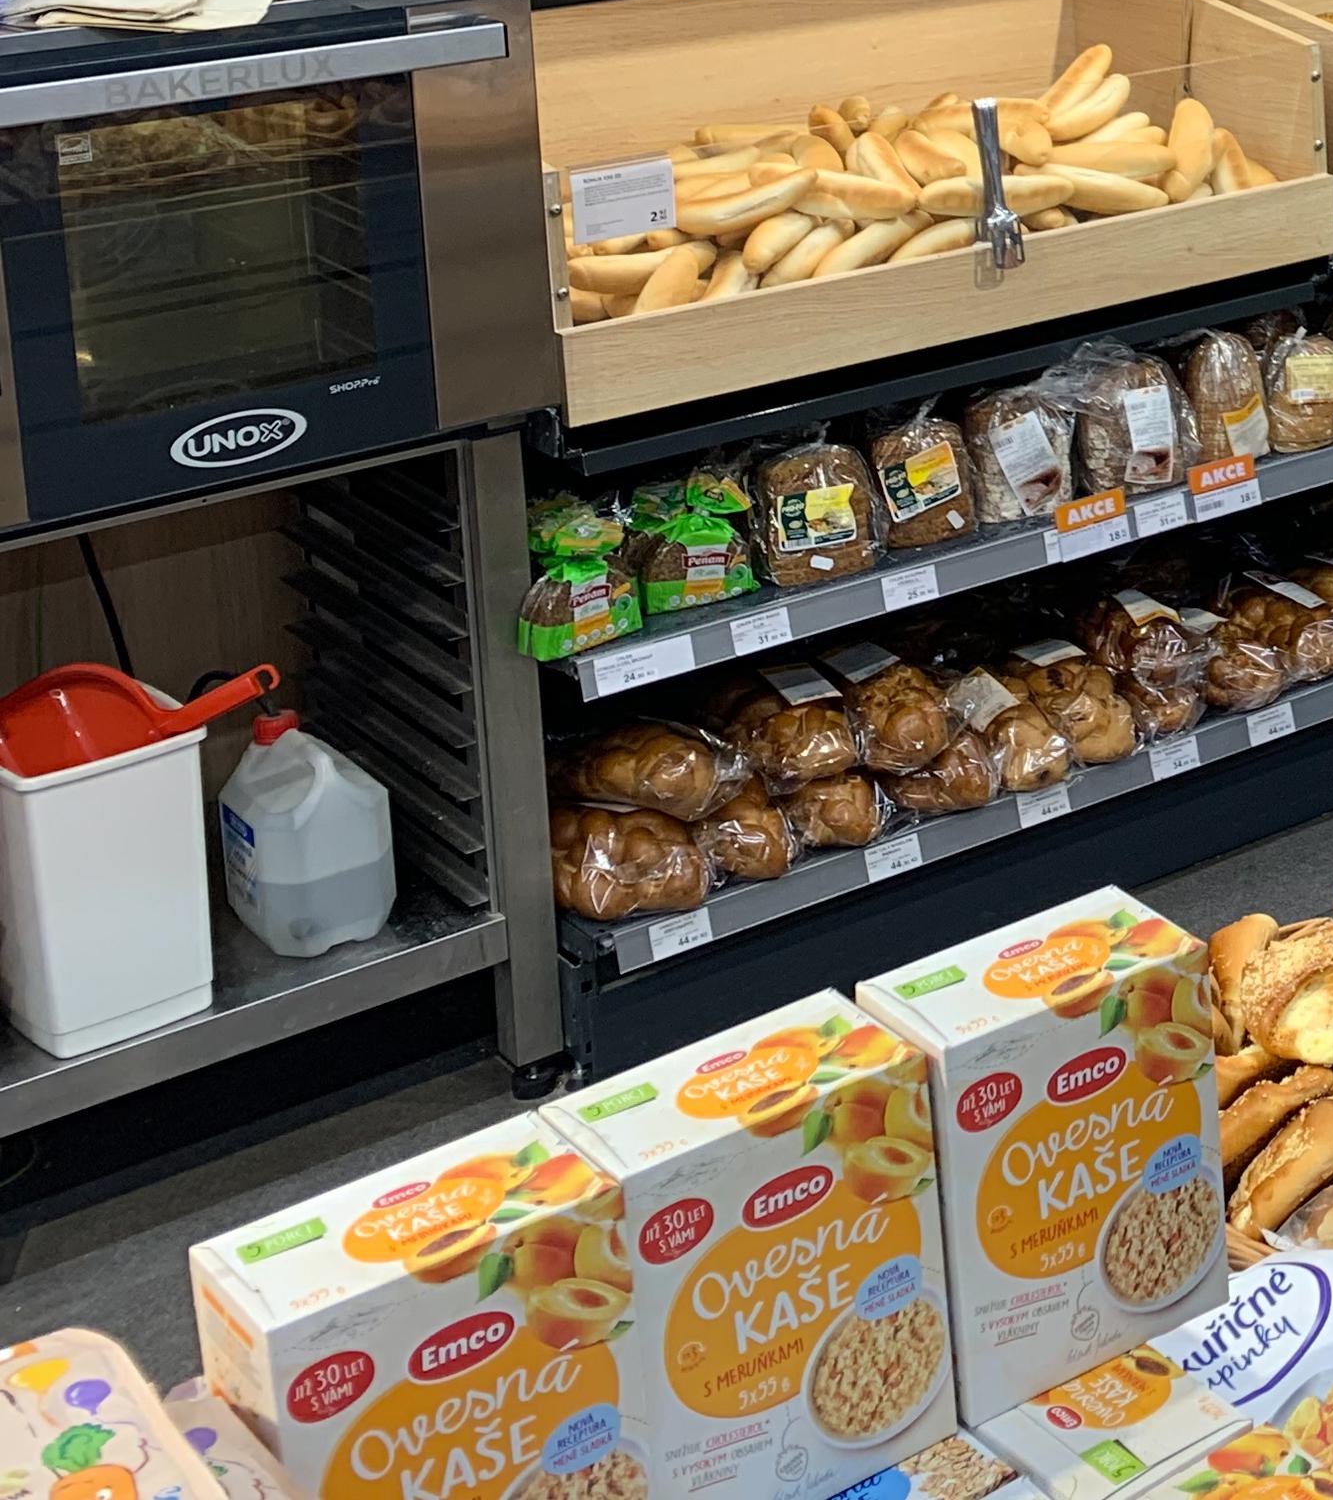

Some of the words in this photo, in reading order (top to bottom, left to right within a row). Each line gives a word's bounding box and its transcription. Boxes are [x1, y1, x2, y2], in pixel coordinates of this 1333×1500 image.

[105, 51, 337, 108] BAKERLUX
[187, 419, 284, 459] UNOX
[1200, 461, 1245, 489] AKCE
[1066, 498, 1116, 525] AKCE
[687, 554, 727, 567] Penam
[571, 586, 607, 606] Penam
[701, 1051, 743, 1074] Emco
[1056, 1055, 1120, 1095] Emco
[715, 1069, 779, 1101] KAŠE
[978, 1081, 998, 1101] 30
[999, 1078, 1016, 1096] LET
[1001, 1075, 1175, 1187] Ovesná
[377, 1182, 427, 1207] Emco
[753, 1174, 825, 1219] Emco
[1037, 1139, 1144, 1220] KAŠE
[663, 1209, 686, 1231] 30
[688, 1205, 706, 1223] LET
[668, 1226, 695, 1250] VÁMI
[1020, 1207, 1099, 1254] MERUŇKAMI
[692, 1191, 890, 1320] Ovesná
[733, 1264, 855, 1354] KAŠE
[420, 1321, 507, 1373] Emco
[716, 1338, 804, 1393] MERUŇKAMI
[314, 1362, 342, 1387] 30
[344, 1356, 365, 1377] LET
[321, 1382, 353, 1408] VÁMI
[350, 1338, 582, 1480] Ovesná
[401, 1415, 541, 1500] KAŠE
